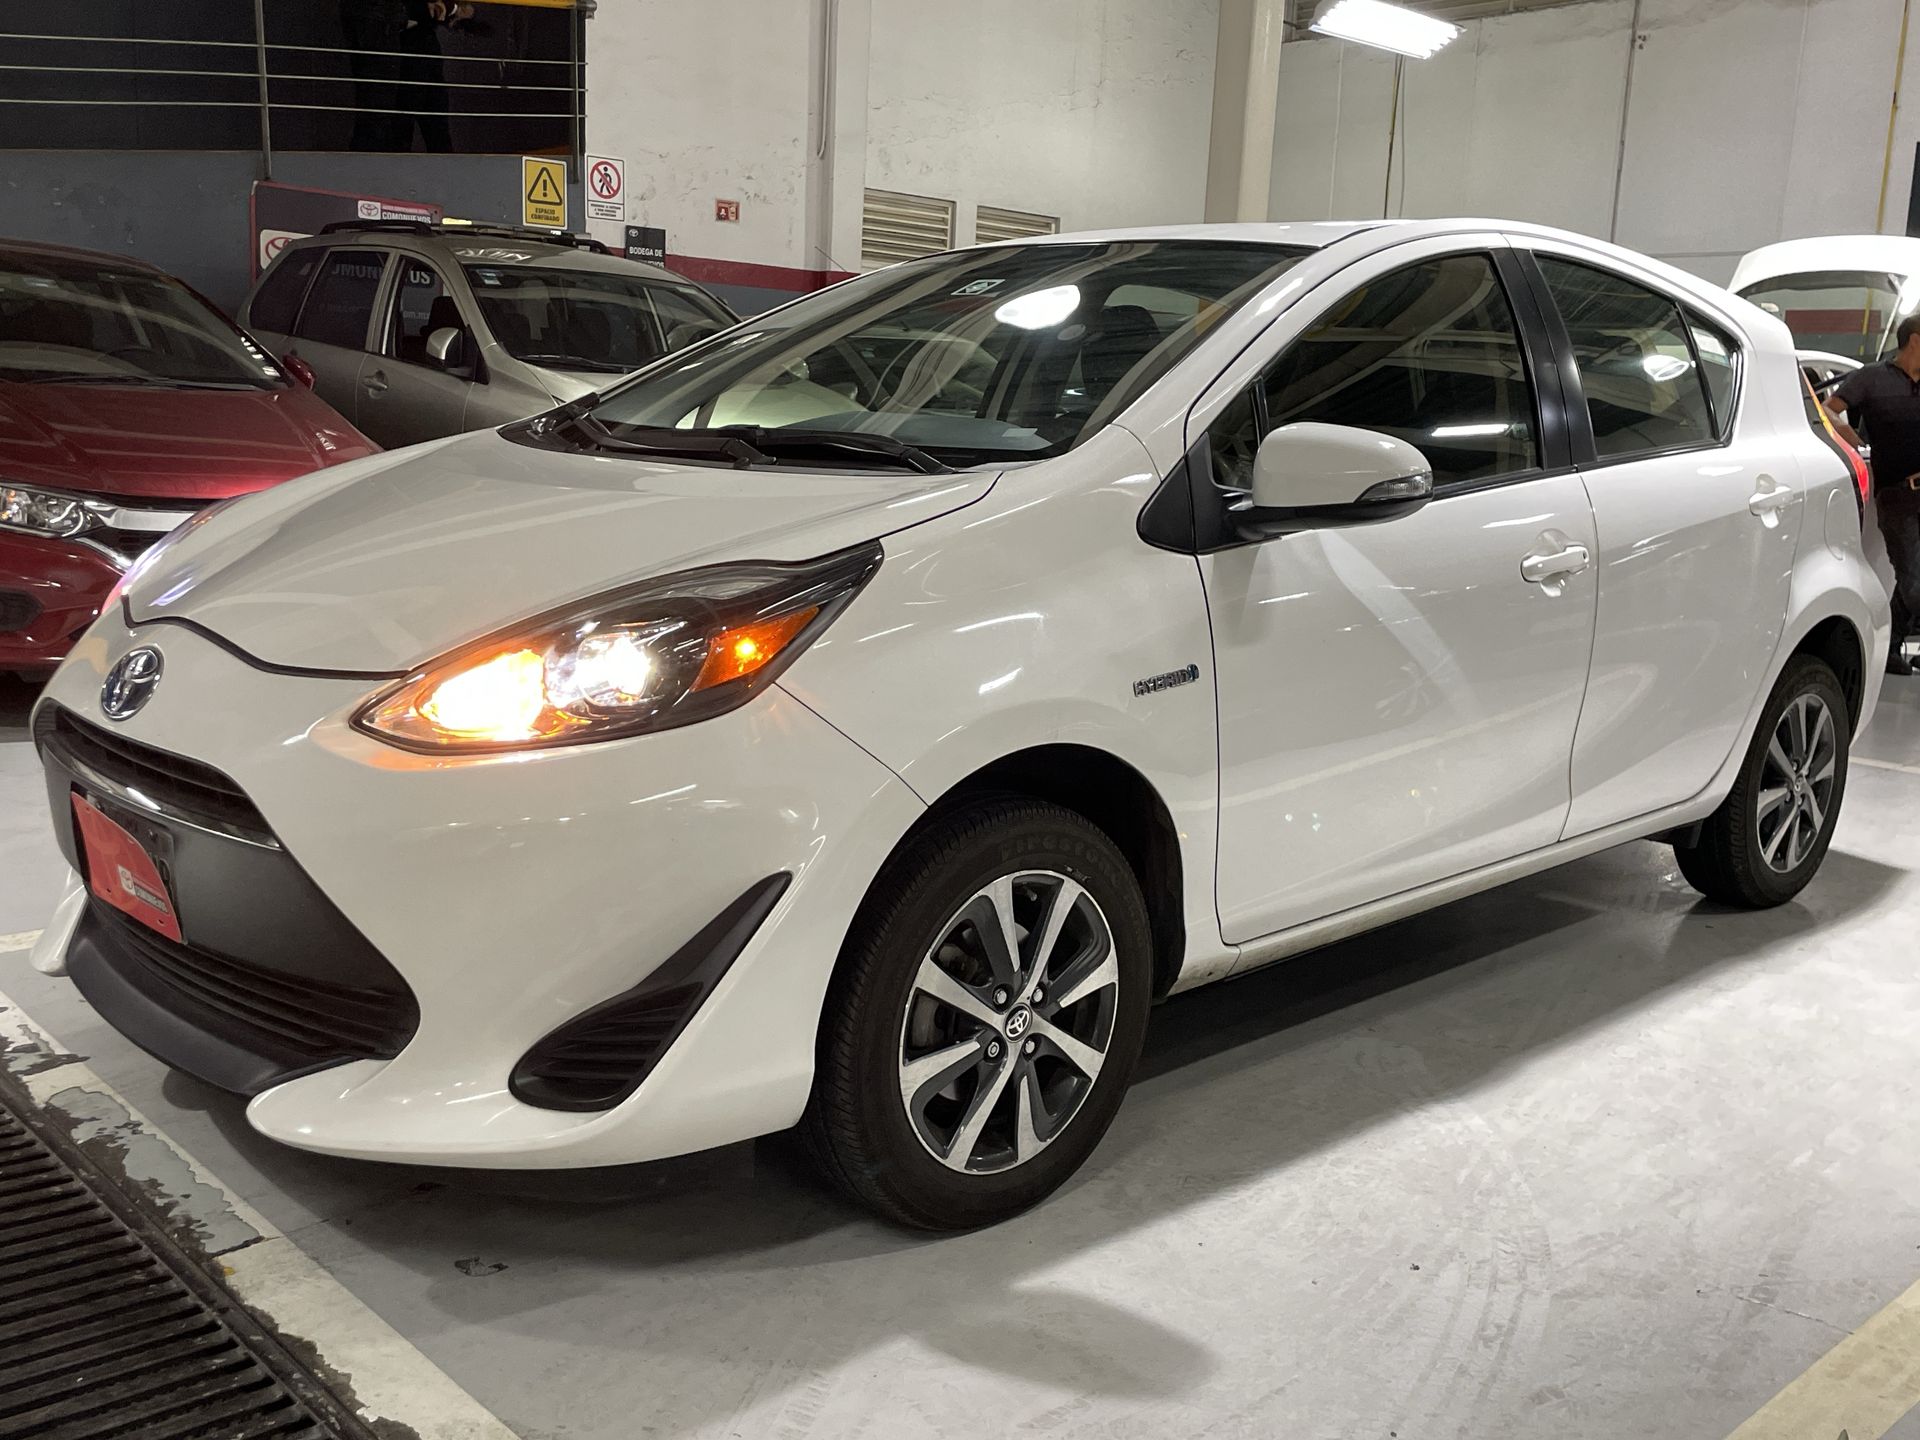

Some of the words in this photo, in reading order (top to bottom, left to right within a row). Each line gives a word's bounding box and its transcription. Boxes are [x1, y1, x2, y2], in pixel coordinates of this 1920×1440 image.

[535, 207, 556, 215] ESPACIO
[629, 246, 654, 256] BODEGA
[654, 249, 663, 257] DE
[1133, 666, 1197, 697] HYBRID
